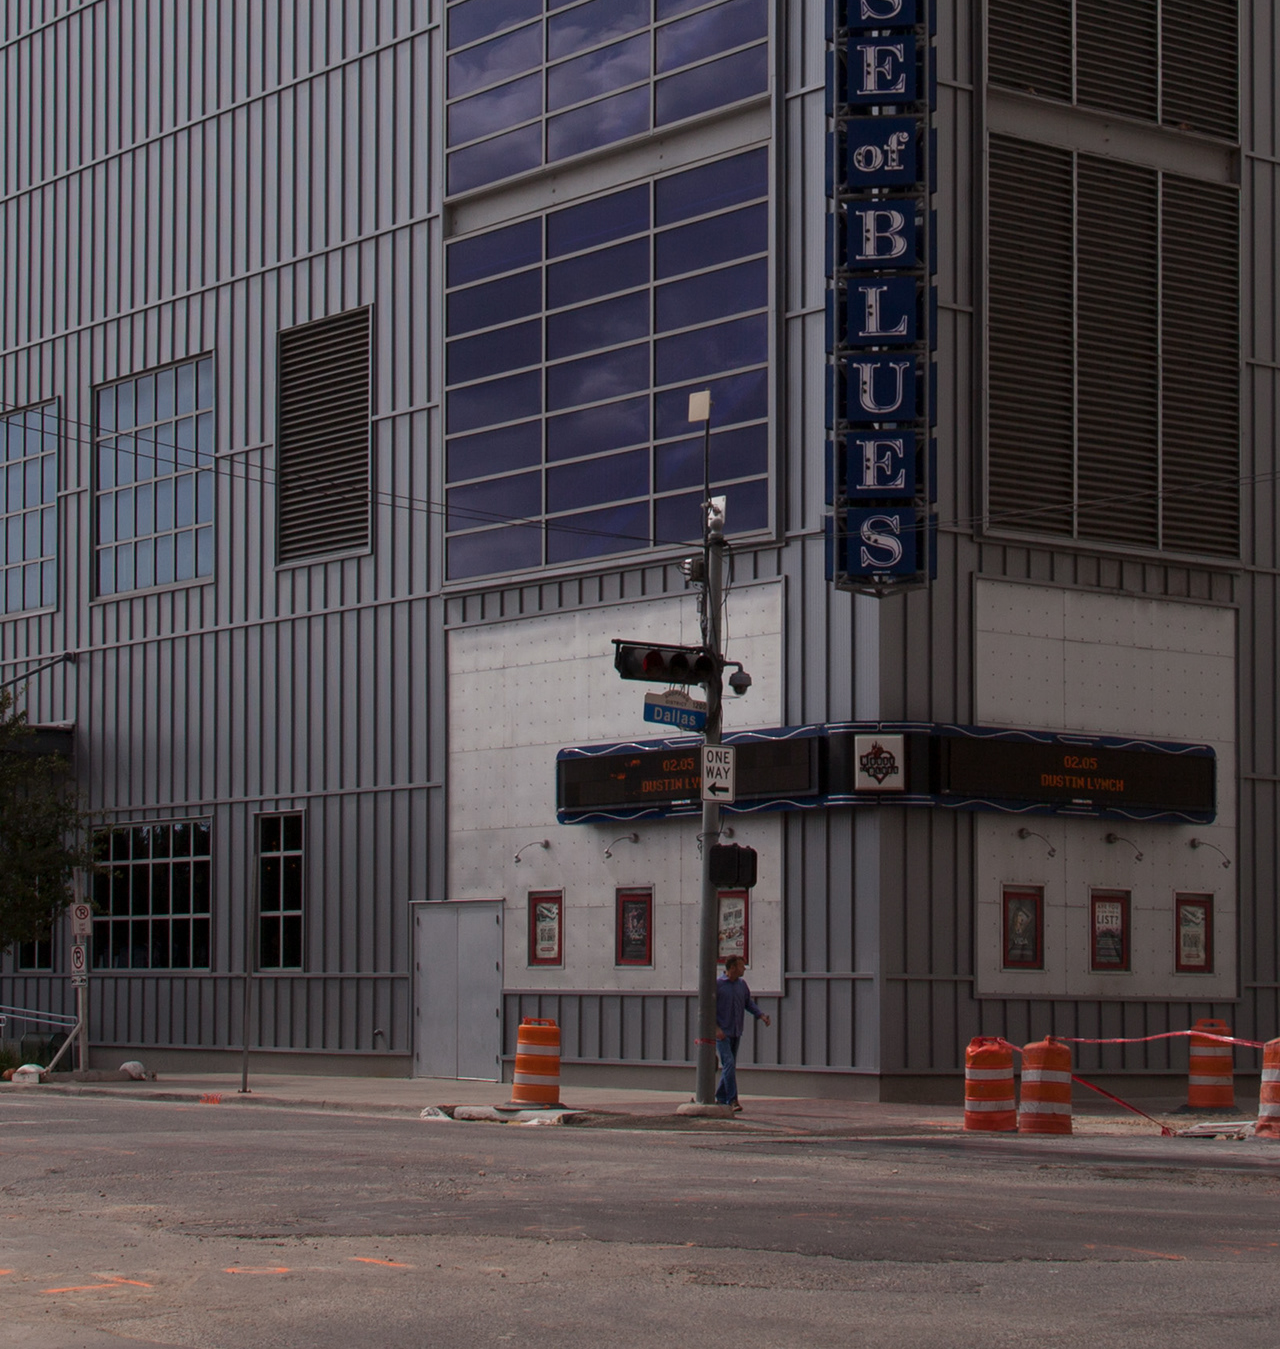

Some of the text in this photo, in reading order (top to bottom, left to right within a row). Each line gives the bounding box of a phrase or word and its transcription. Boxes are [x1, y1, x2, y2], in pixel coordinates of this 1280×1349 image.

[852, 131, 910, 171] of
[853, 209, 910, 568] BLUES
[654, 706, 696, 726] Dallas
[662, 758, 695, 772] 02.05
[706, 750, 730, 765] ONE
[1063, 755, 1098, 770] 02.05
[705, 765, 731, 780] WAY
[642, 777, 682, 793] DUSTIN
[1040, 773, 1124, 792] DUSTIN LYNCH
[1096, 914, 1119, 925] LIST?
